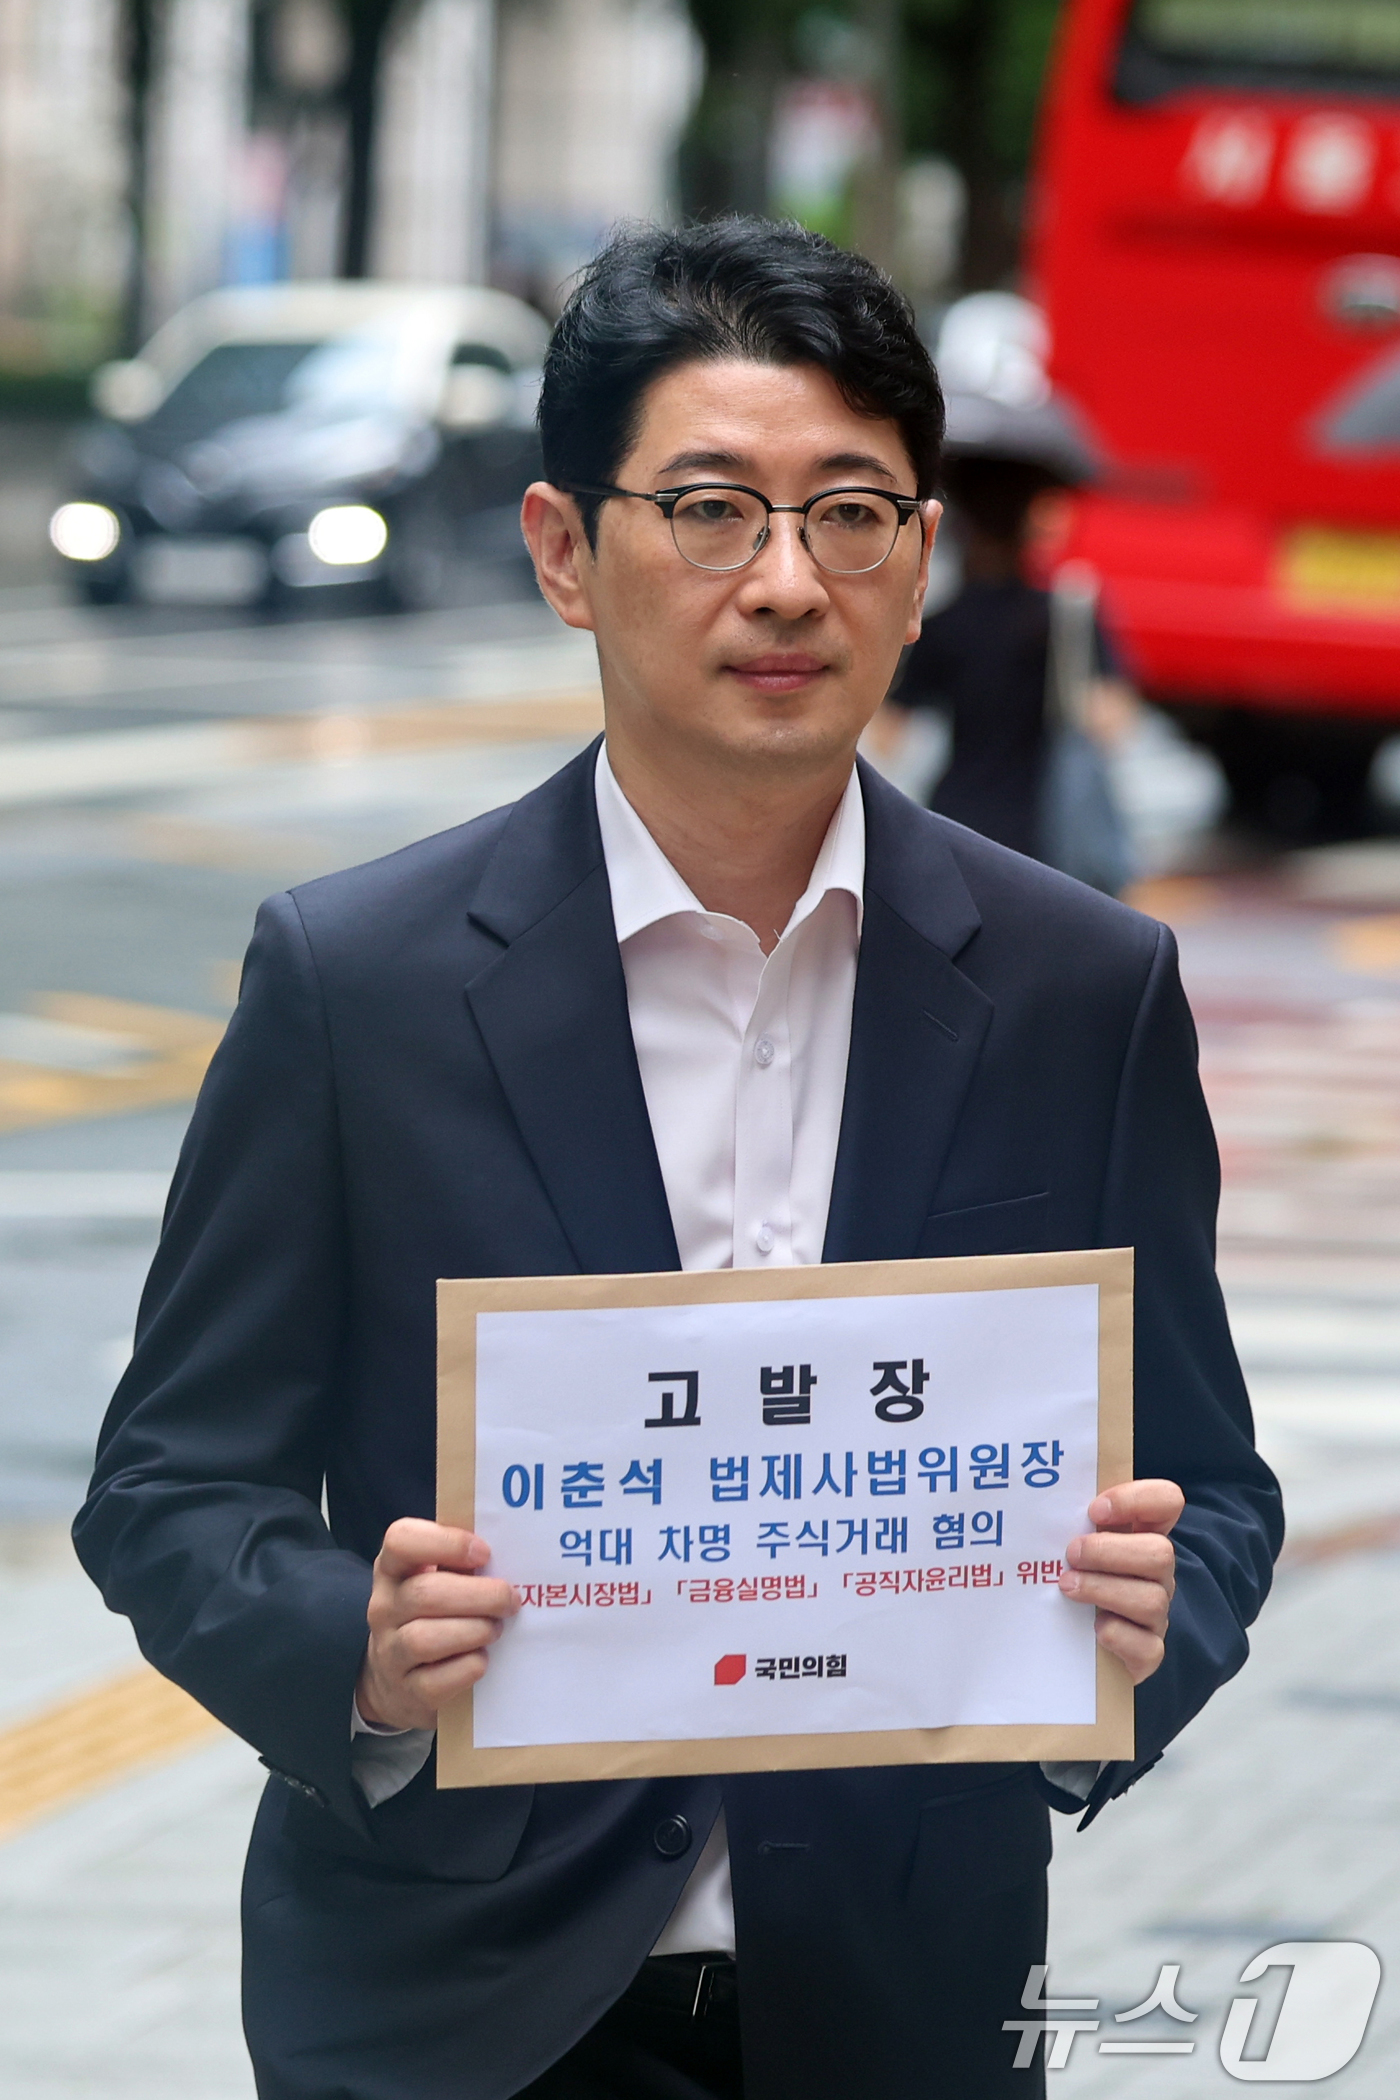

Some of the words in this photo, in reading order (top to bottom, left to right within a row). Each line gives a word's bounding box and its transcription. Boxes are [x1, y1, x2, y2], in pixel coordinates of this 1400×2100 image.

[501, 1458, 663, 1511] 이춘석
[709, 1439, 1065, 1503] 법제사법위원장
[559, 1527, 633, 1567] 억대
[657, 1523, 731, 1563] 차명
[756, 1516, 908, 1560] 주식거래
[932, 1510, 1003, 1551] 혐의
[1016, 1559, 1063, 1585] 위반
[754, 1654, 847, 1681] 국민의힘
